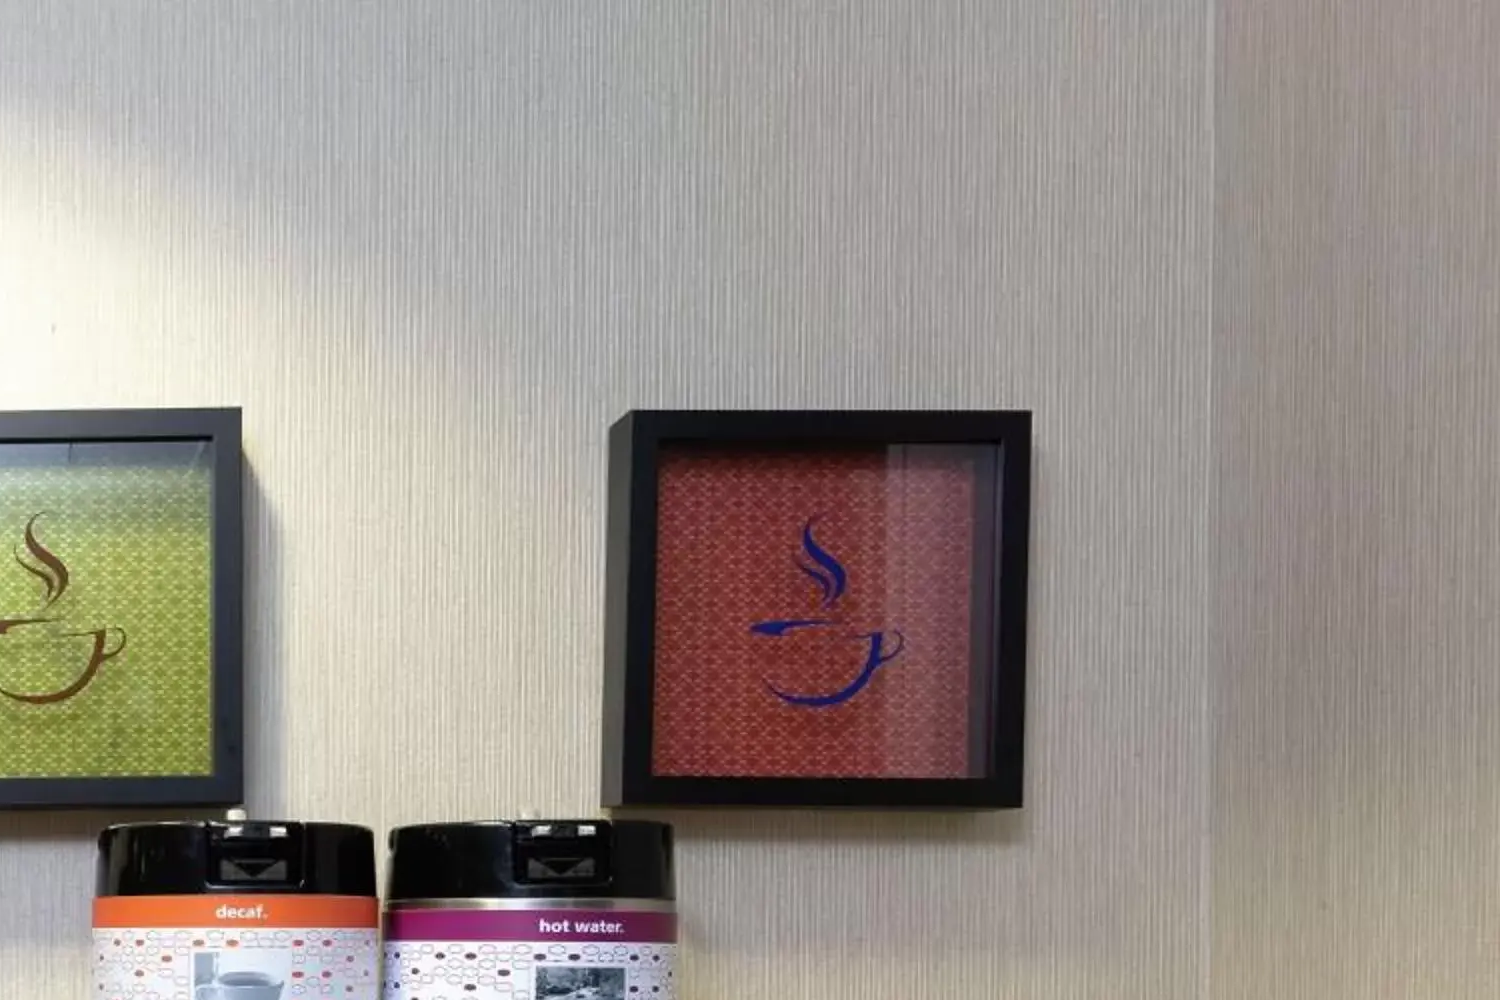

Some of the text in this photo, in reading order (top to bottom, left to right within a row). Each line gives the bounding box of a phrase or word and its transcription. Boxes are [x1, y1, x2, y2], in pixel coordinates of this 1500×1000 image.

[215, 903, 269, 920] decaf.
[538, 918, 625, 933] hot water.
